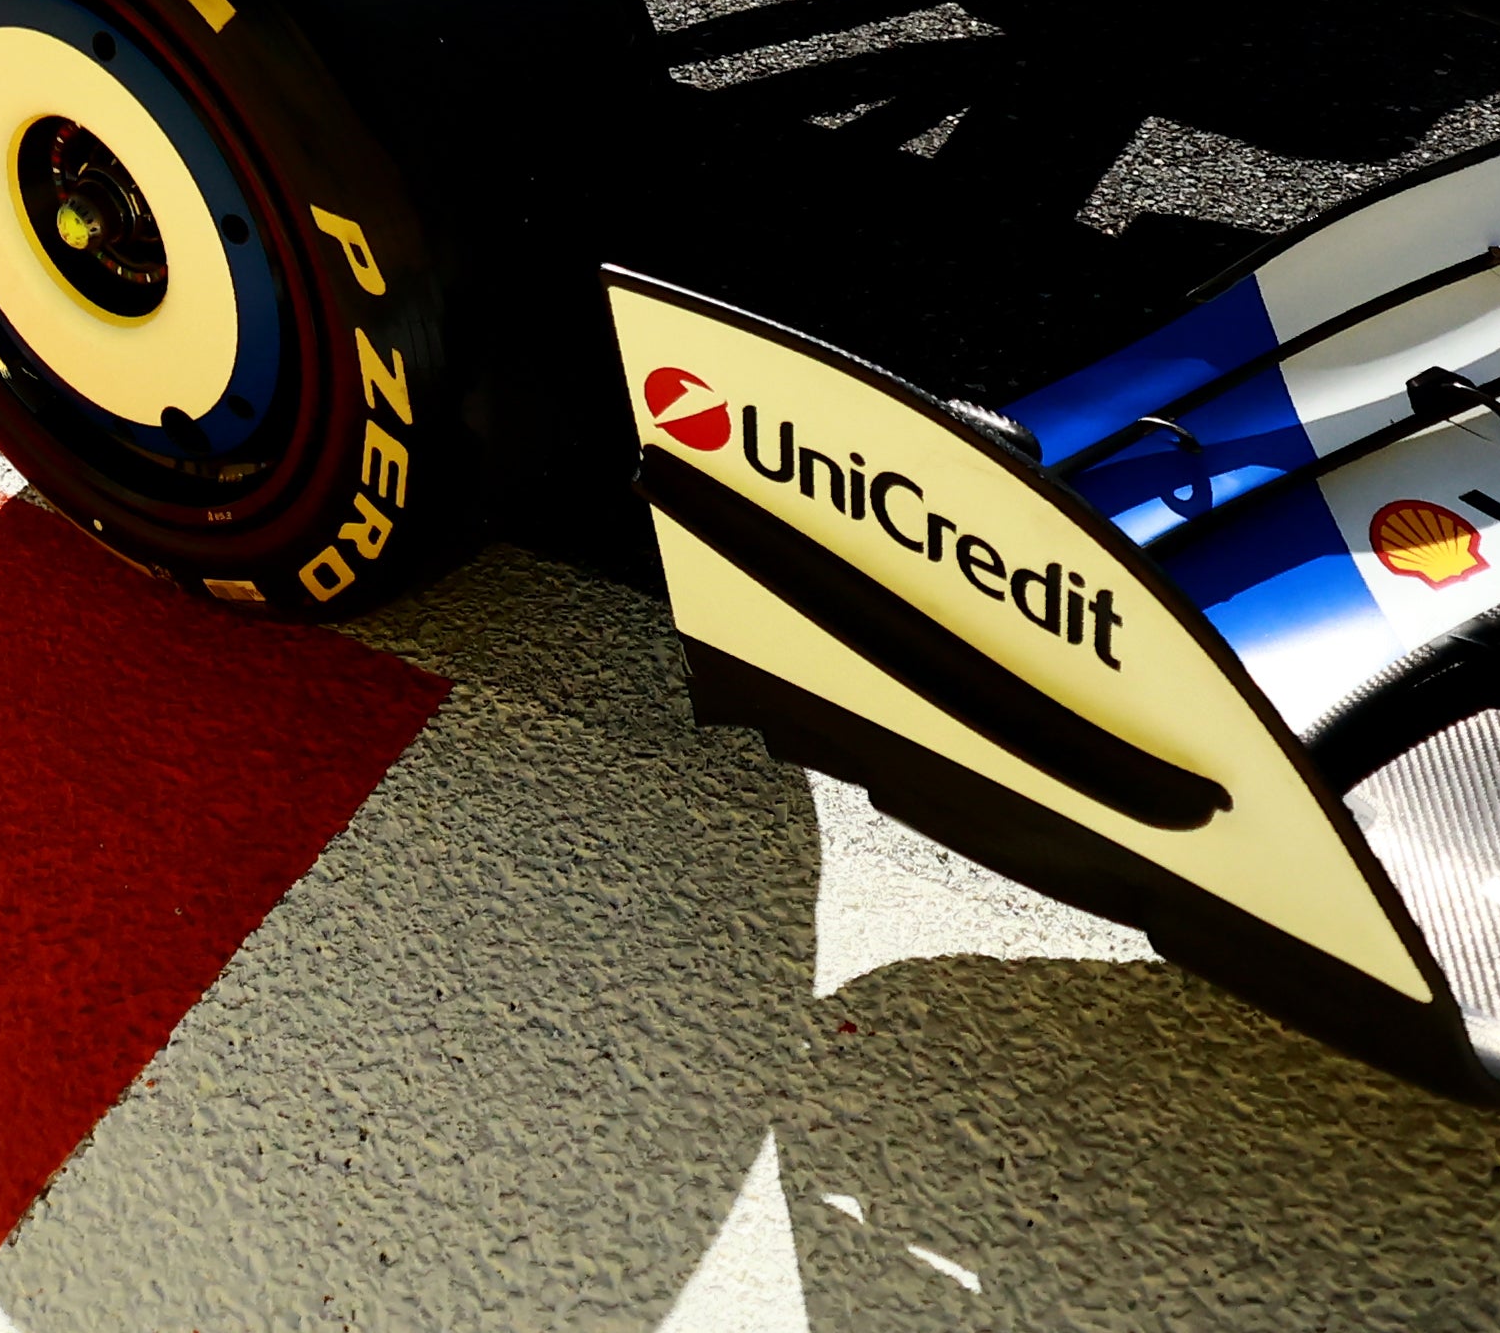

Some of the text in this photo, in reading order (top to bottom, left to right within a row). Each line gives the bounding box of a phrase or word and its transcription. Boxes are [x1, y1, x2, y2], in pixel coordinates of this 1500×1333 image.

[298, 203, 413, 602] P ZERO
[741, 403, 1124, 671] UniCredit
